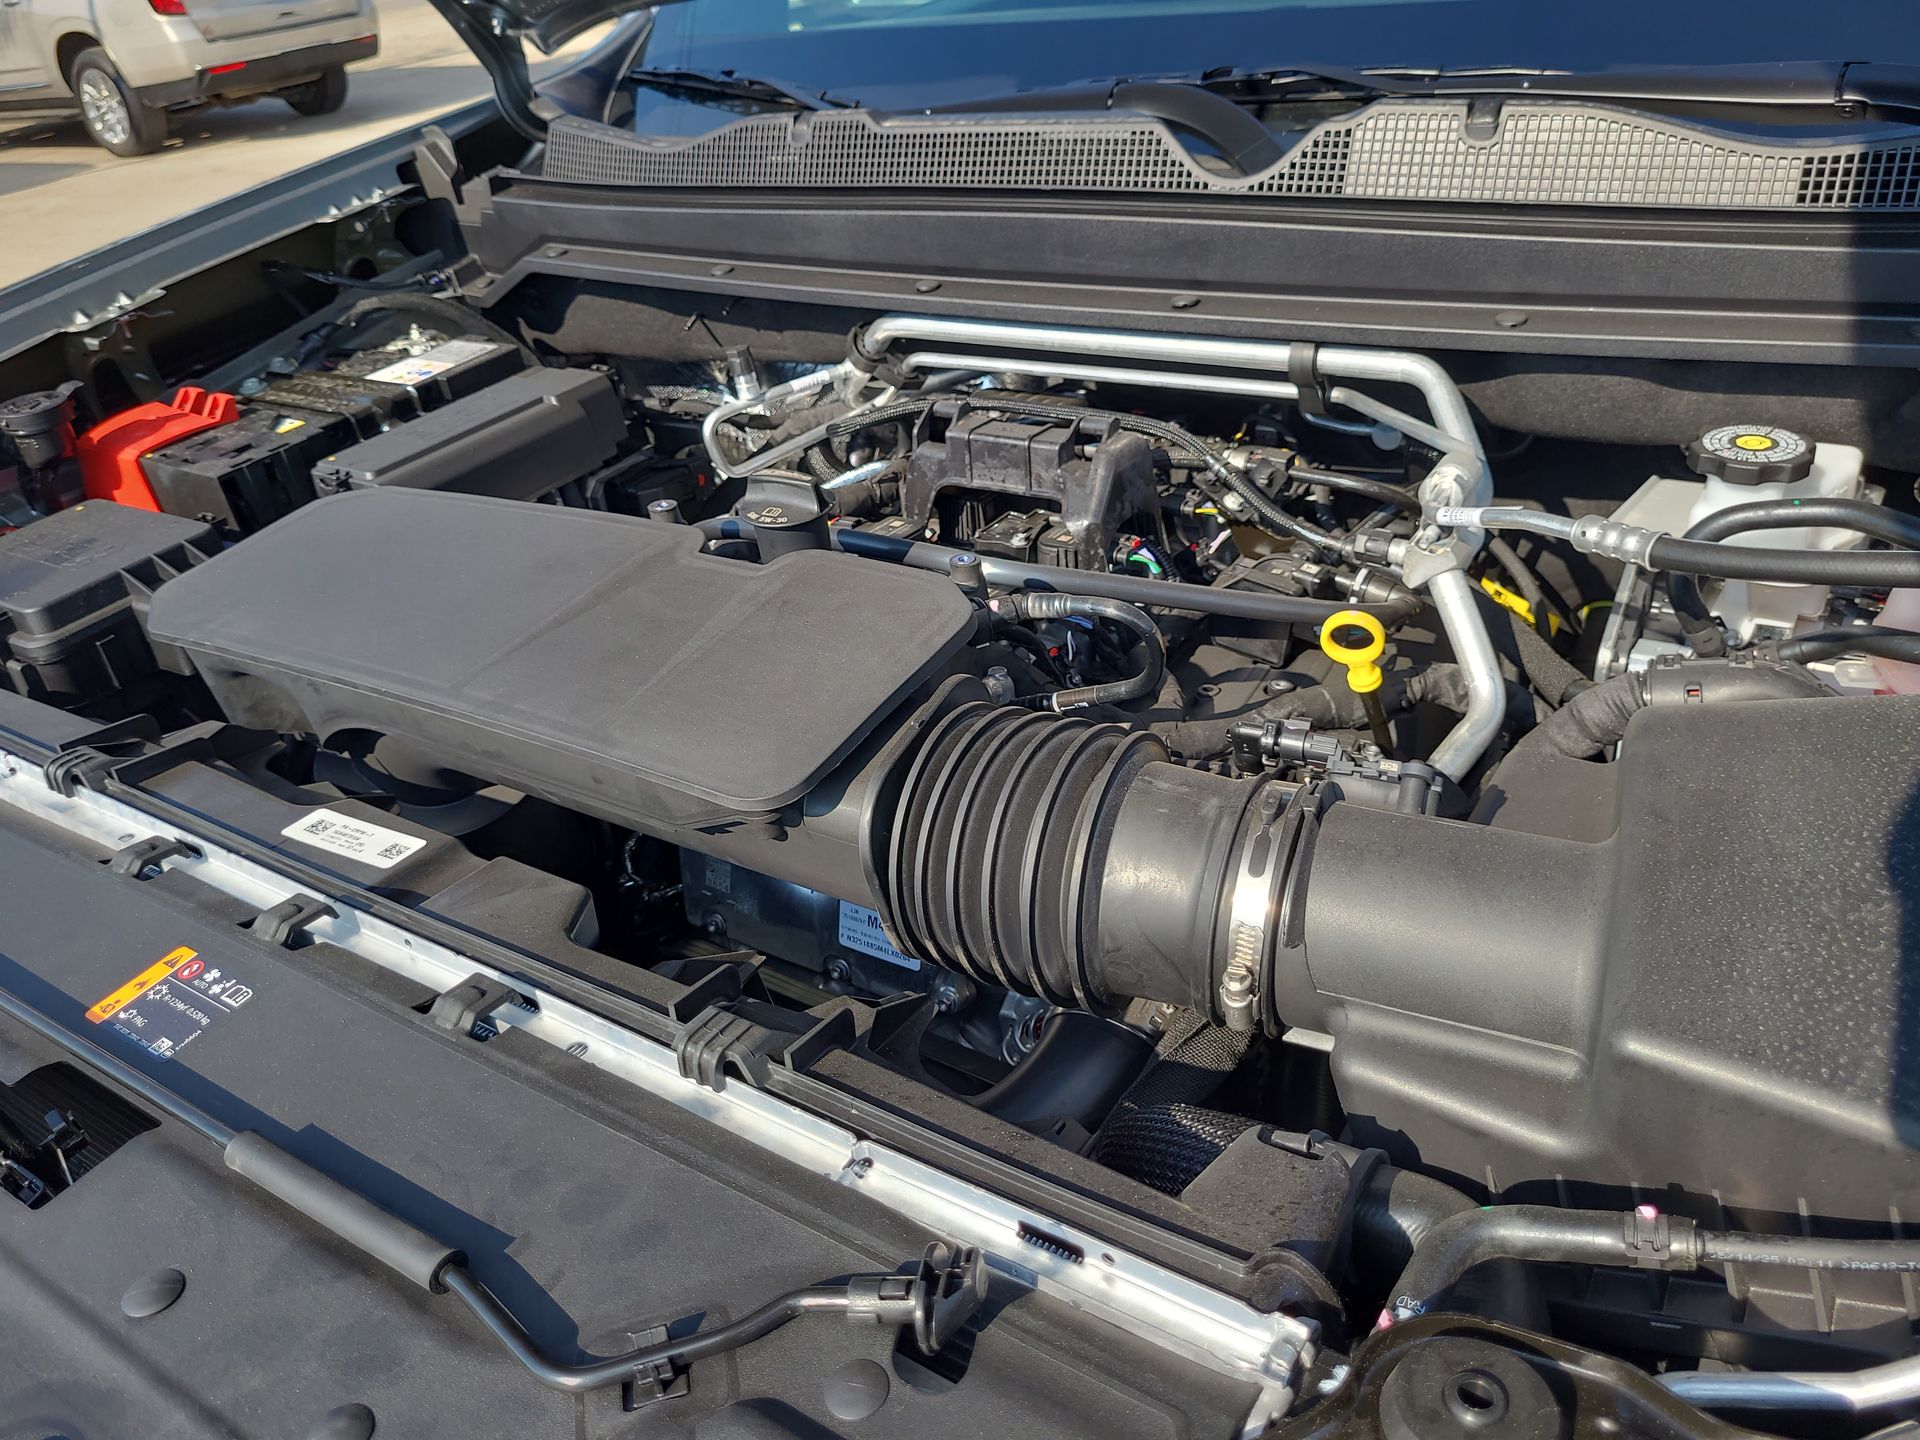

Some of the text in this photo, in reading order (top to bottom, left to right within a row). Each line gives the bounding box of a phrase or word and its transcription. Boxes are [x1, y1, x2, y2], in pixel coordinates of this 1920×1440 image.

[192, 978, 209, 990] AUTO
[163, 994, 211, 1026] R-1234yf 0.520 kg
[131, 1015, 149, 1027] PAG
[1396, 1295, 1426, 1314] RAD
